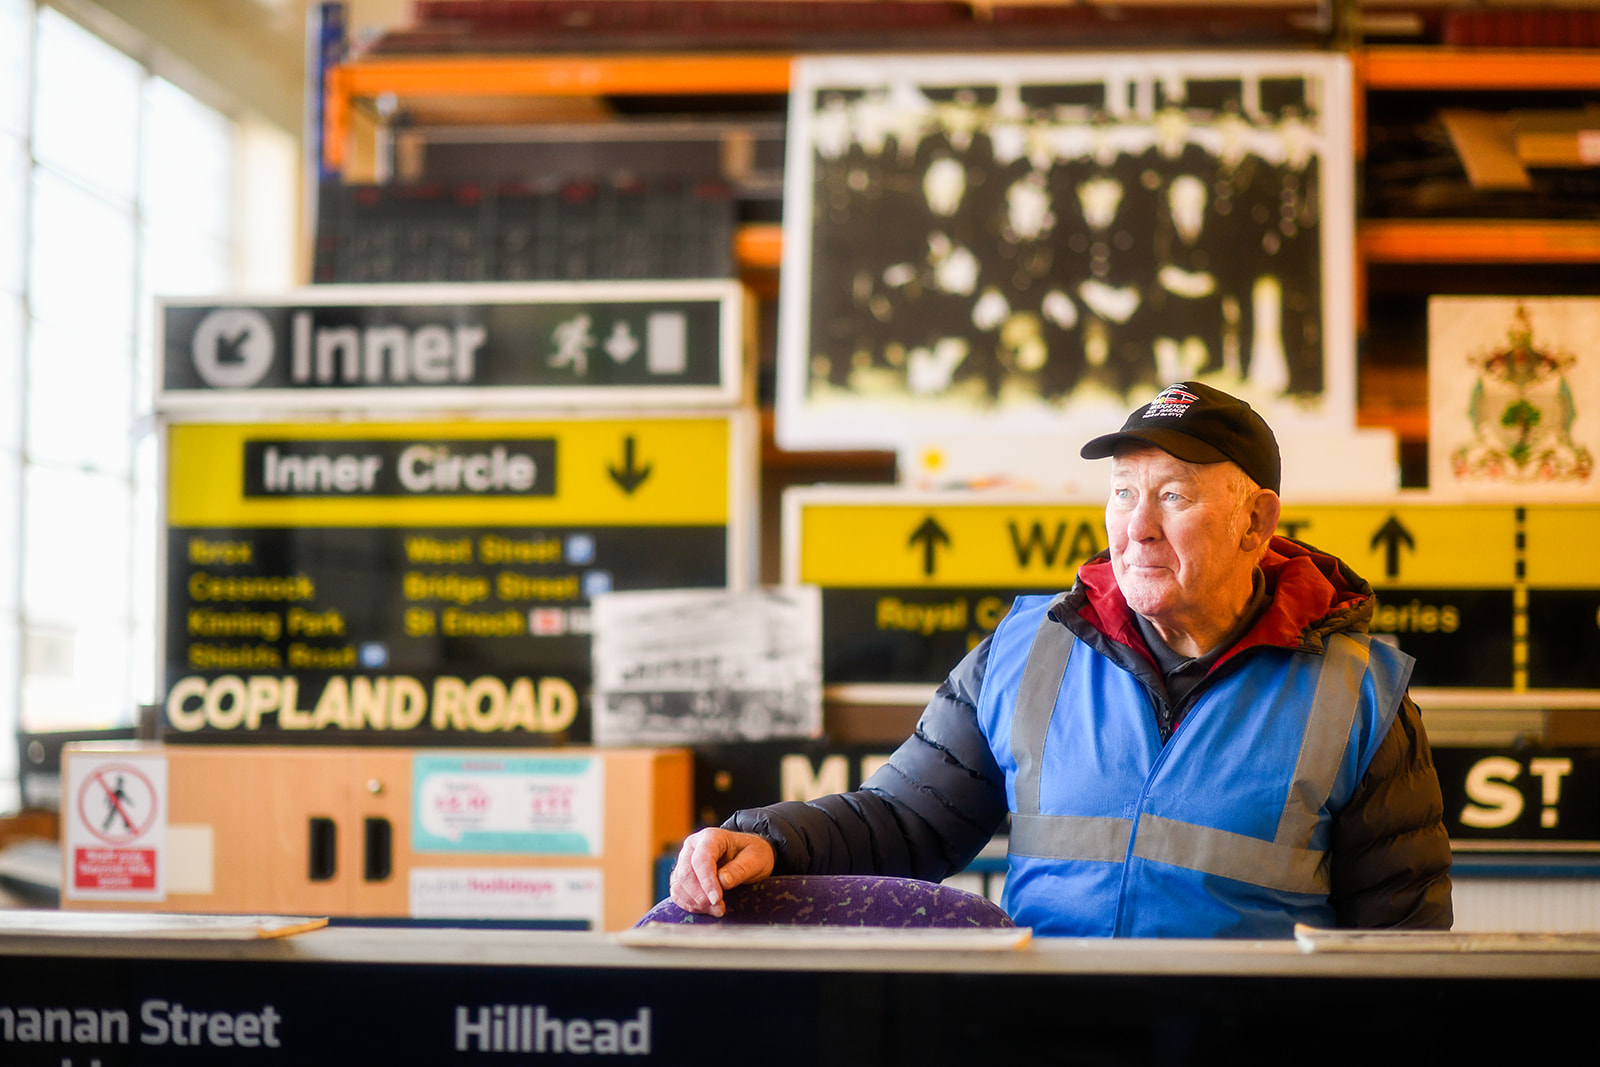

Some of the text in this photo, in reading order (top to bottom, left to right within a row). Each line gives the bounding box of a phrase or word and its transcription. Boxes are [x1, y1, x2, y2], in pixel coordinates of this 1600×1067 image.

[292, 310, 487, 384] Inner
[262, 444, 538, 492] Inner Circle
[405, 536, 473, 565] West
[480, 535, 562, 565] Street
[1006, 520, 1106, 569] WA
[189, 571, 314, 602] Cessnock
[403, 571, 490, 605] Bridge
[497, 570, 580, 601] Street
[188, 606, 346, 641] Kinning Park
[404, 606, 527, 637] St Enoch
[877, 596, 968, 635] Royal
[166, 675, 579, 733] COPLAND ROAD
[140, 999, 282, 1048] Street
[456, 1004, 652, 1056] Hillhead
